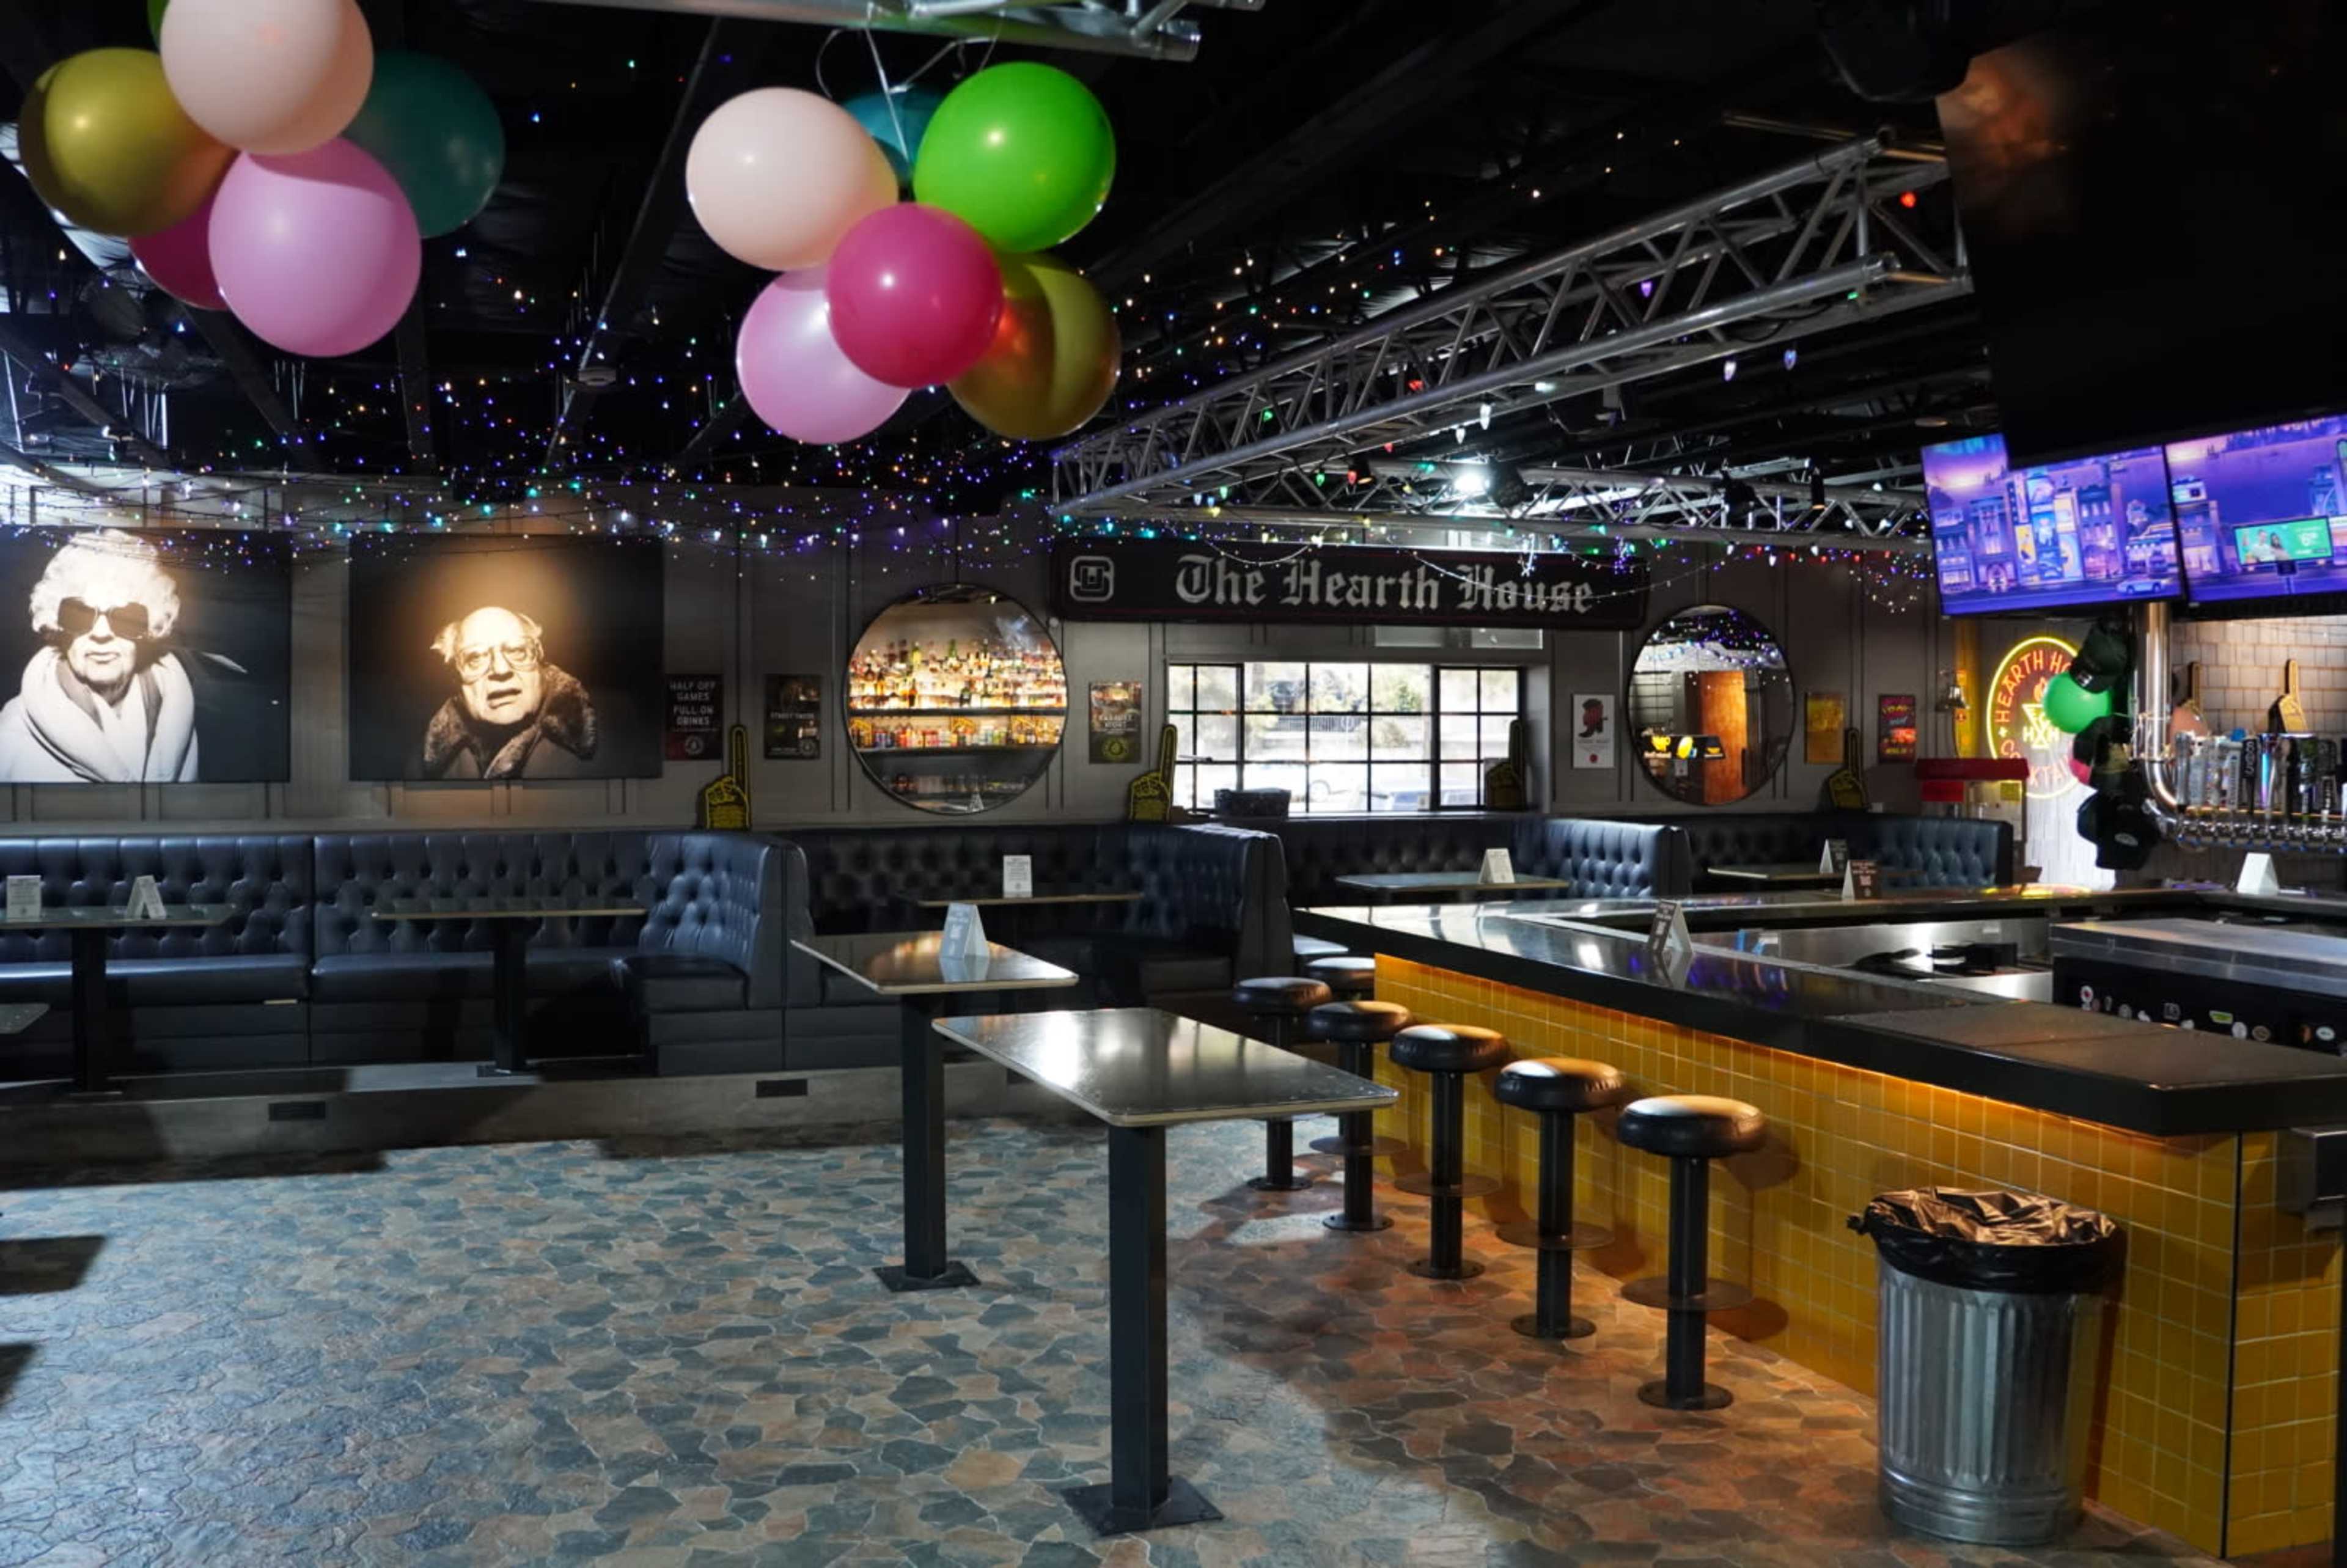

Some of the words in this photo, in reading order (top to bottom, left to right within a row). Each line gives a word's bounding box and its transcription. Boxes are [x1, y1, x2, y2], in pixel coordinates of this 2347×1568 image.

[1175, 554, 1267, 605] The
[1280, 559, 1440, 609] Hearth
[1457, 563, 1593, 614] House
[670, 681, 695, 691] HALF
[697, 680, 716, 690] OFF
[1995, 649, 2044, 723] HEARTH
[677, 692, 710, 702] GAMES
[674, 705, 699, 715] FULL
[700, 705, 713, 715] ON
[677, 716, 710, 726] DRINKS
